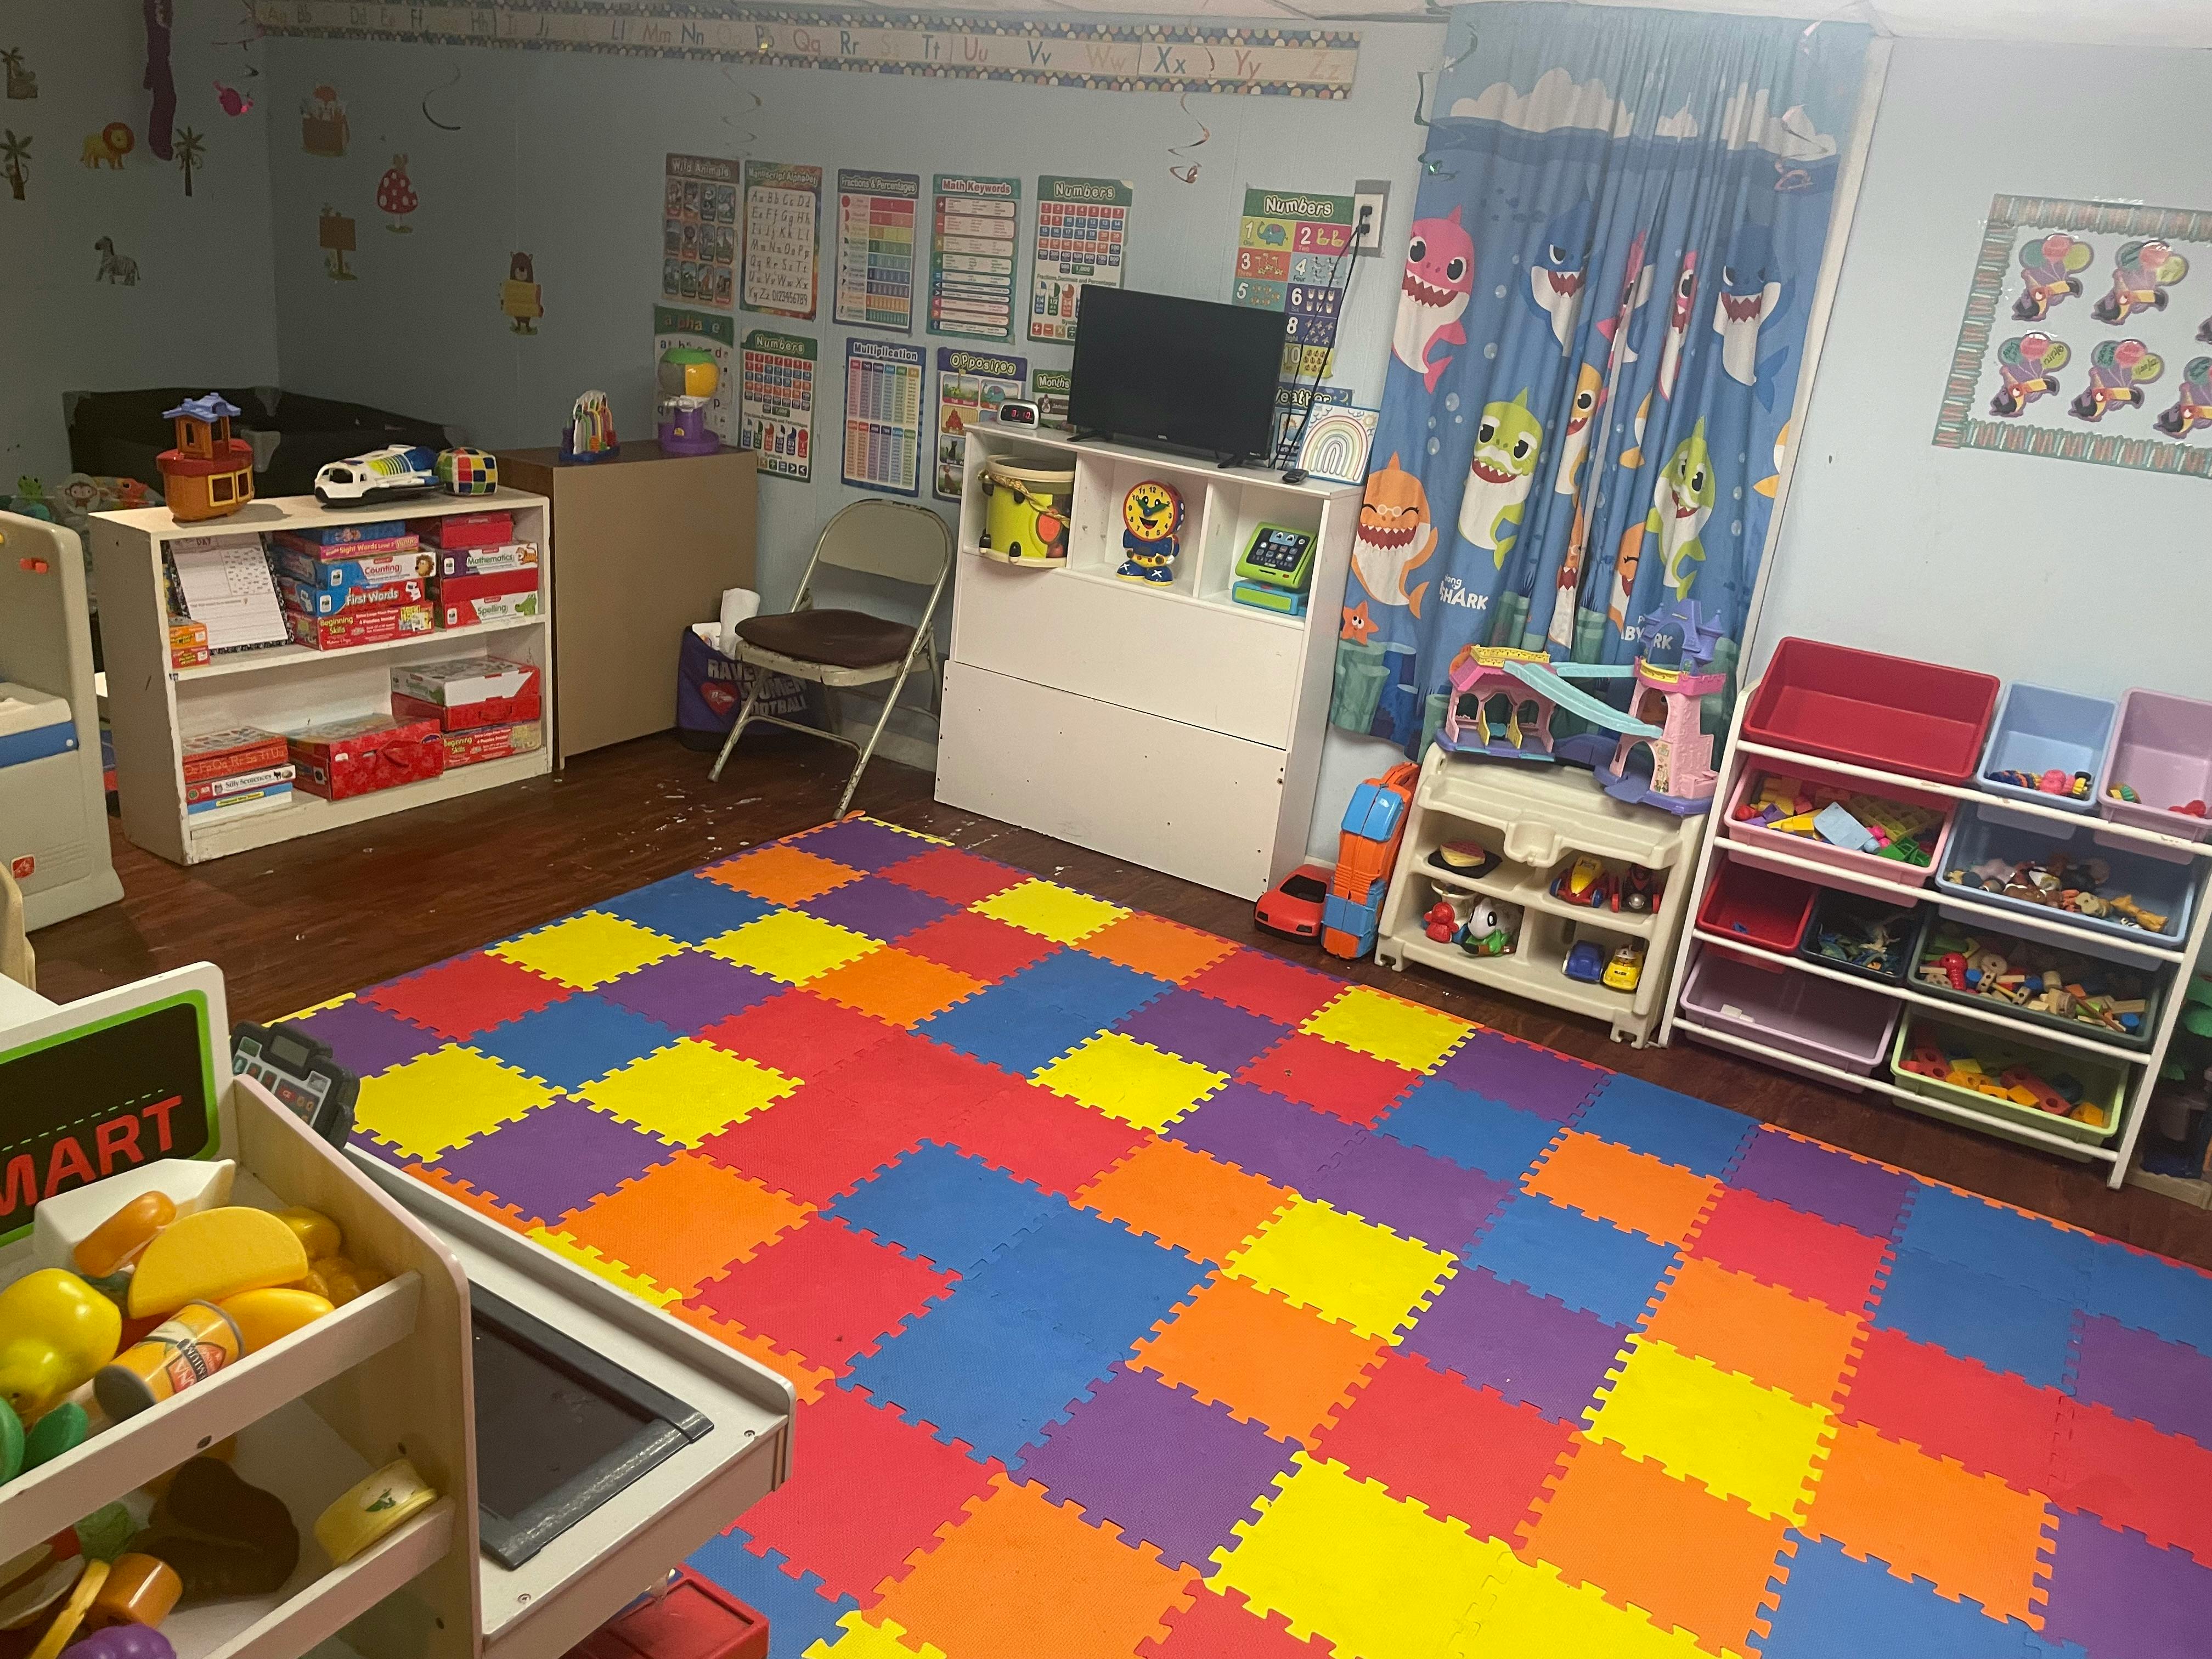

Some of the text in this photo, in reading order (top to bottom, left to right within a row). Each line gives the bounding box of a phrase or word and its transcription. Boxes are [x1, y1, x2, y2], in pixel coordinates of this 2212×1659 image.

[681, 23, 704, 45] Nn
[840, 31, 859, 55] Rr
[922, 34, 940, 59] Tt
[1026, 40, 1052, 66] Vv
[1153, 46, 1187, 75] Xx
[1234, 49, 1262, 80] Yy
[876, 179, 916, 194] Percentages
[943, 179, 1011, 194] Math Keywords
[1055, 182, 1114, 199] Numbers
[1264, 195, 1334, 216] Numbers
[1245, 222, 1312, 245] 1 2
[1241, 252, 1307, 276] 3 4
[1236, 281, 1302, 306] 5 6
[1286, 317, 1298, 335] 8
[755, 335, 804, 353] Numbers
[854, 342, 918, 361] Multiplication
[951, 353, 1015, 375] Opposites
[1283, 346, 1301, 364] 10
[1038, 375, 1070, 389] Months
[1275, 387, 1331, 408] eather
[339, 545, 356, 555] Sight
[357, 543, 378, 551] Words
[467, 553, 514, 565] Mathematics
[364, 565, 400, 576] Counting
[347, 589, 399, 606] First Words
[477, 604, 507, 616] Spelling
[320, 616, 353, 627] Beginning
[330, 626, 346, 635] Skills
[708, 658, 768, 682] RAVE
[225, 781, 239, 789] Silly
[184, 1342, 207, 1381] MIUM
